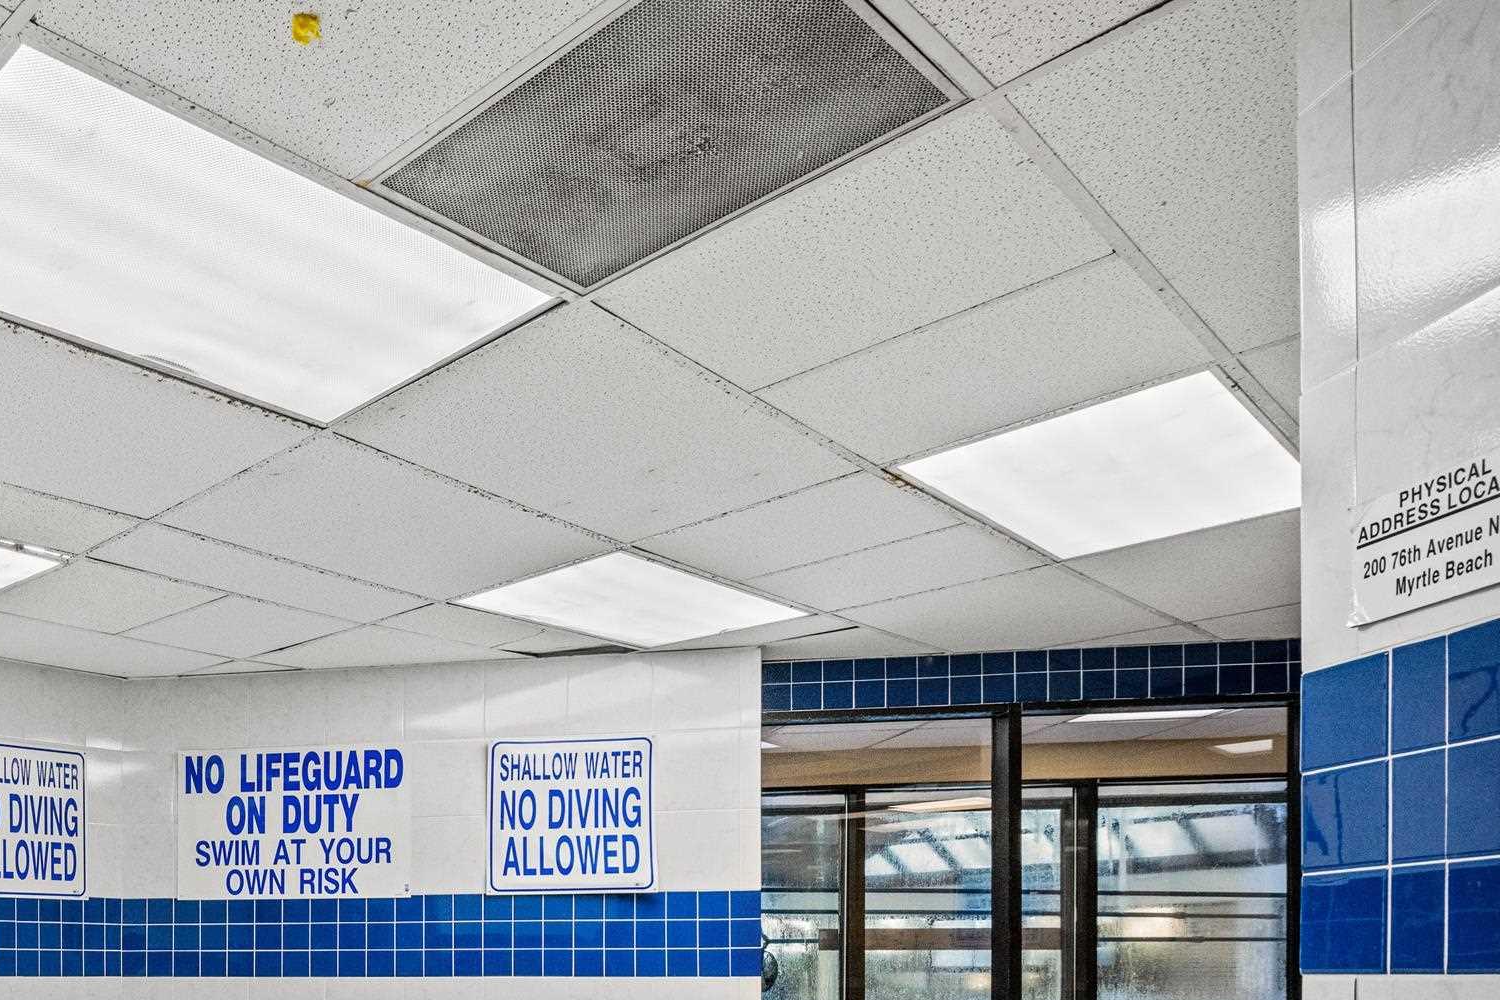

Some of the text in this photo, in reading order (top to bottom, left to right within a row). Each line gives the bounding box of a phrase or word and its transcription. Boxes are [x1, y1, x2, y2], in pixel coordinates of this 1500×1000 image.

[1400, 458, 1492, 508] PHYSICAL
[1358, 476, 1500, 543] ADDRESS LOCA
[1364, 556, 1387, 579] 200
[1391, 544, 1421, 570] 76th
[1426, 526, 1483, 558] Avenue
[1396, 549, 1493, 597] Myrtle Beach
[37, 760, 79, 790] WATER
[185, 749, 404, 794] NO LIFEGUARD
[500, 750, 643, 782] SHALLOW WATER
[10, 794, 78, 837] DIVING
[226, 794, 359, 835] ON DUTY
[500, 786, 642, 831] NO DIVING
[196, 837, 392, 867] SWIM AT YOUR
[502, 834, 640, 876] ALLOWED
[226, 868, 359, 895] OWN RISK
